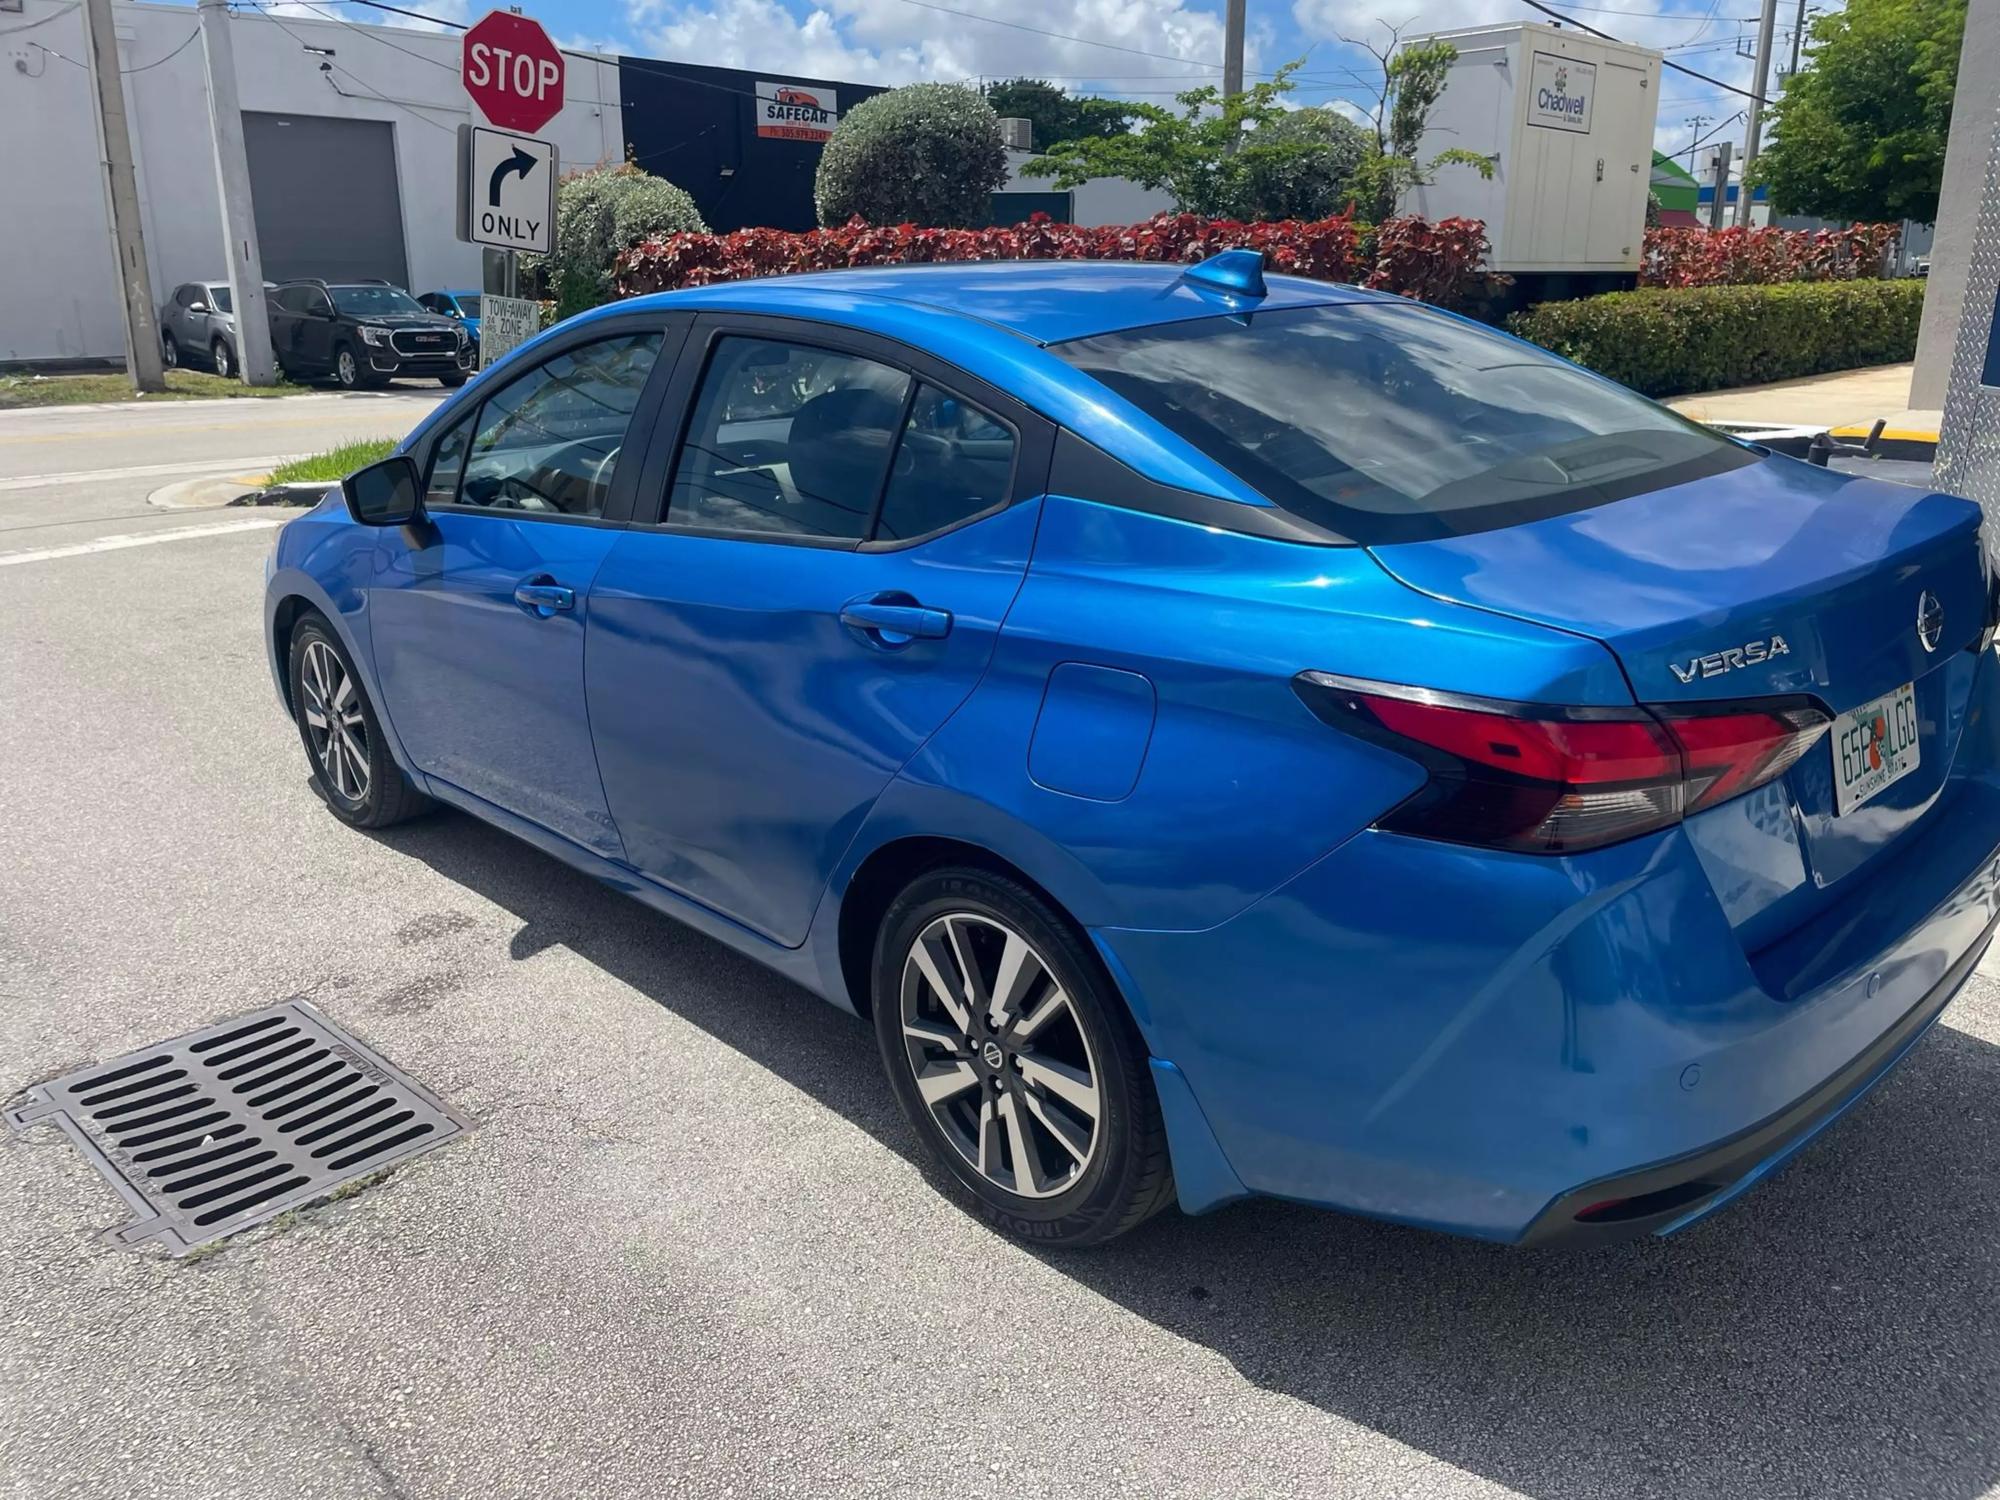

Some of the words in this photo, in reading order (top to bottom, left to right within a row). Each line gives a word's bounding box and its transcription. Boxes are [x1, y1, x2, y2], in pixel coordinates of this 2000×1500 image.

[468, 43, 560, 101] STOP
[767, 105, 828, 123] SAFECAR
[1538, 87, 1585, 115] Chadwell
[482, 212, 541, 241] ONLY
[489, 299, 533, 320] TOW-AWAY
[500, 318, 522, 336] ZONE
[1669, 635, 1790, 683] VERSA
[1887, 695, 1917, 757] LGG
